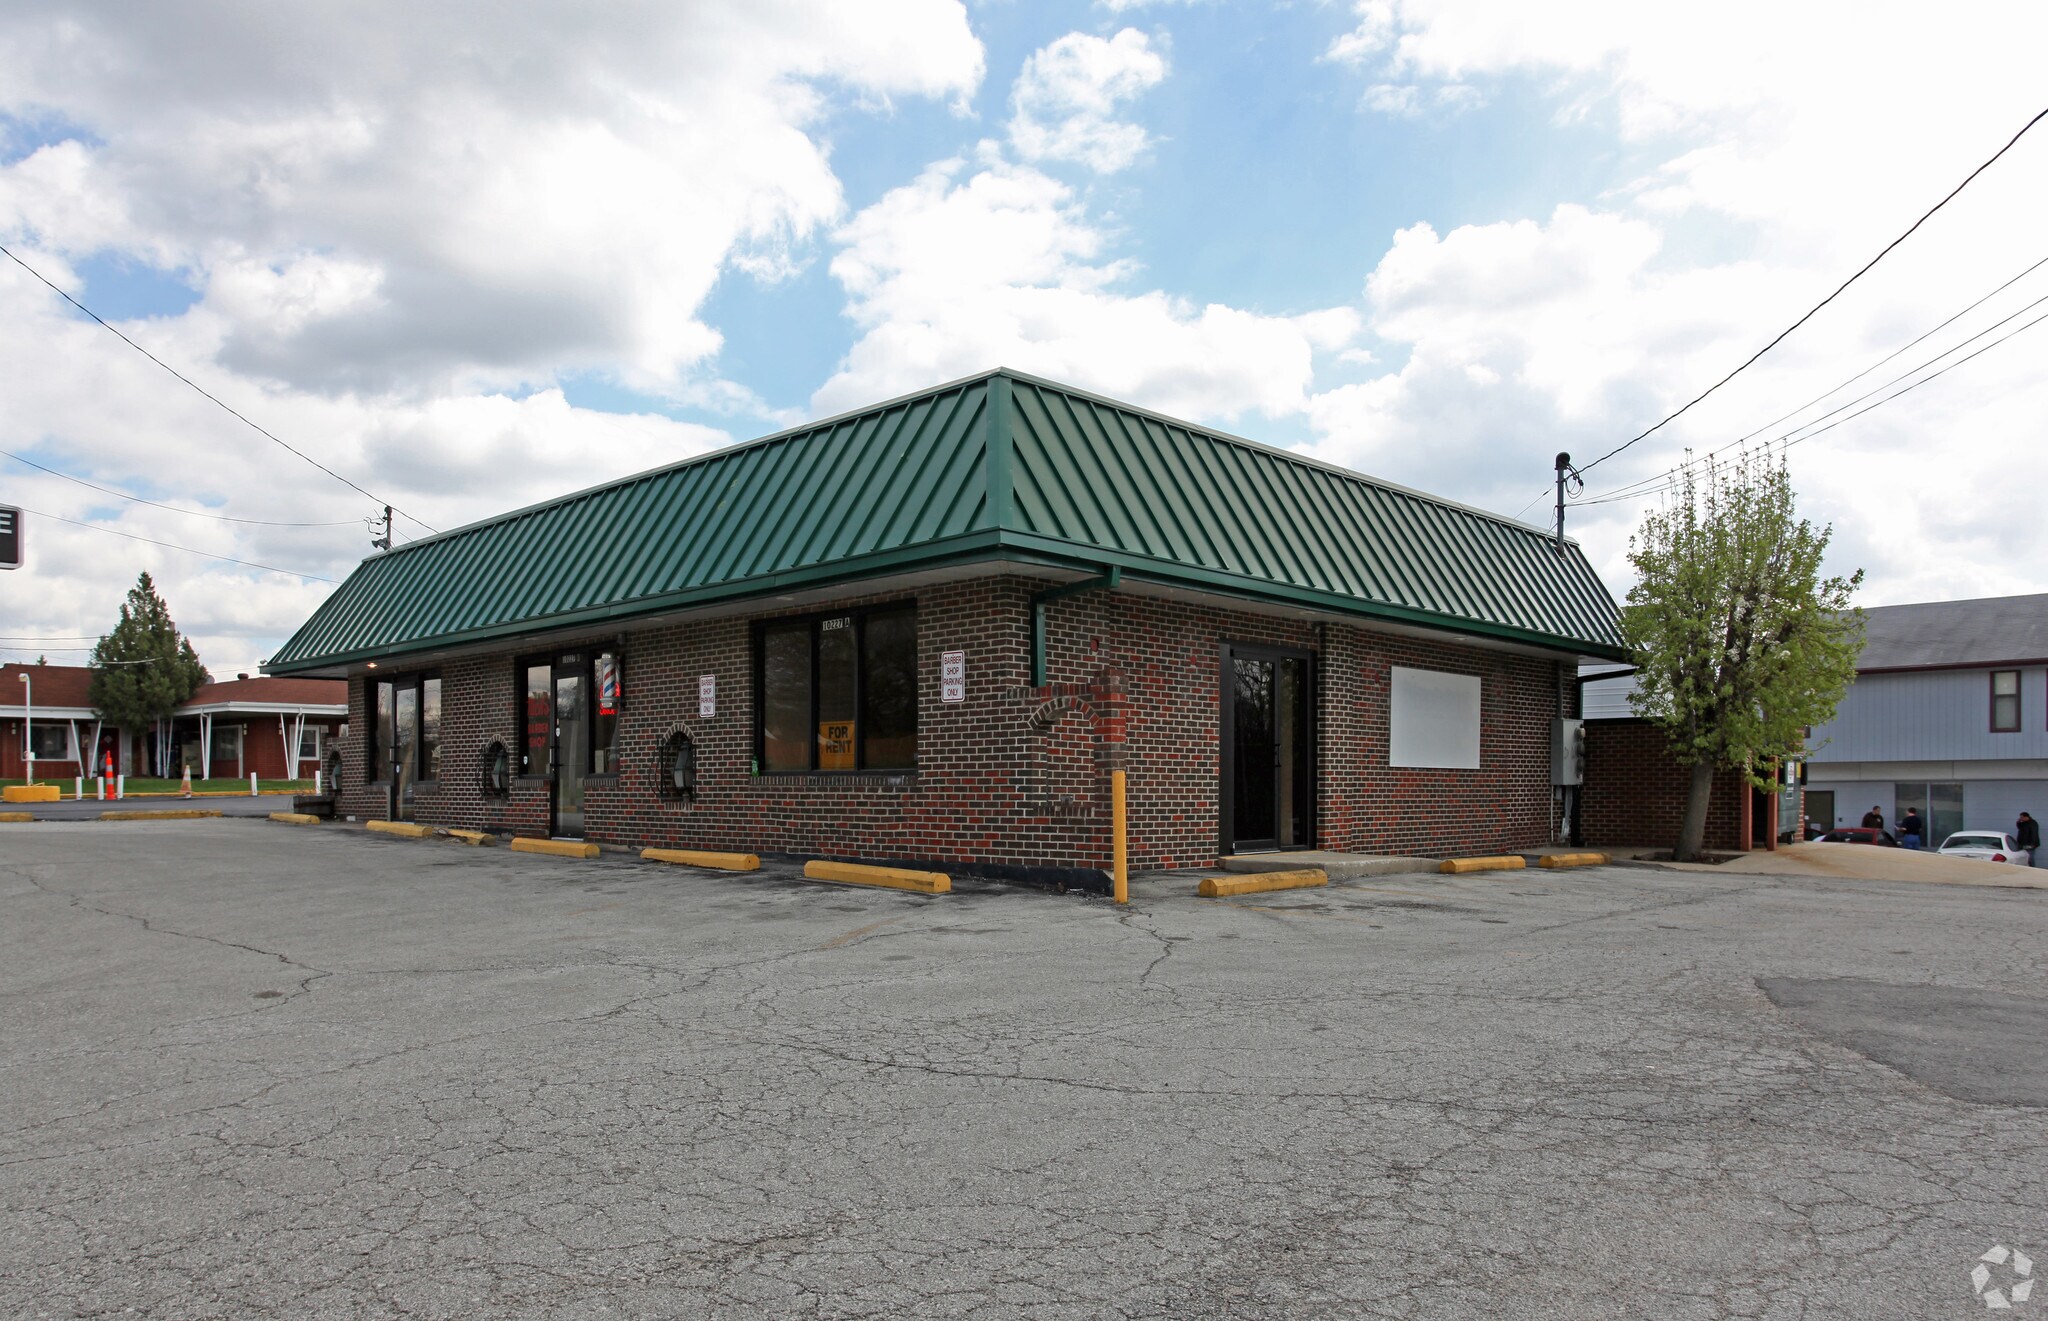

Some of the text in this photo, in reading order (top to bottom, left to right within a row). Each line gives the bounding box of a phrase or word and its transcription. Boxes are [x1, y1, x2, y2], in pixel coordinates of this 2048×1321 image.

[823, 618, 843, 631] 10227
[944, 655, 961, 665] BARBER
[946, 666, 959, 675] SHOP
[701, 678, 713, 687] BARBER
[943, 677, 962, 686] PARKING
[702, 687, 712, 695] SHOP
[947, 688, 959, 697] ONLY
[700, 696, 714, 704] PARKING
[703, 705, 712, 713] ONLY
[828, 726, 848, 739] FOR
[825, 740, 852, 754] RENT
